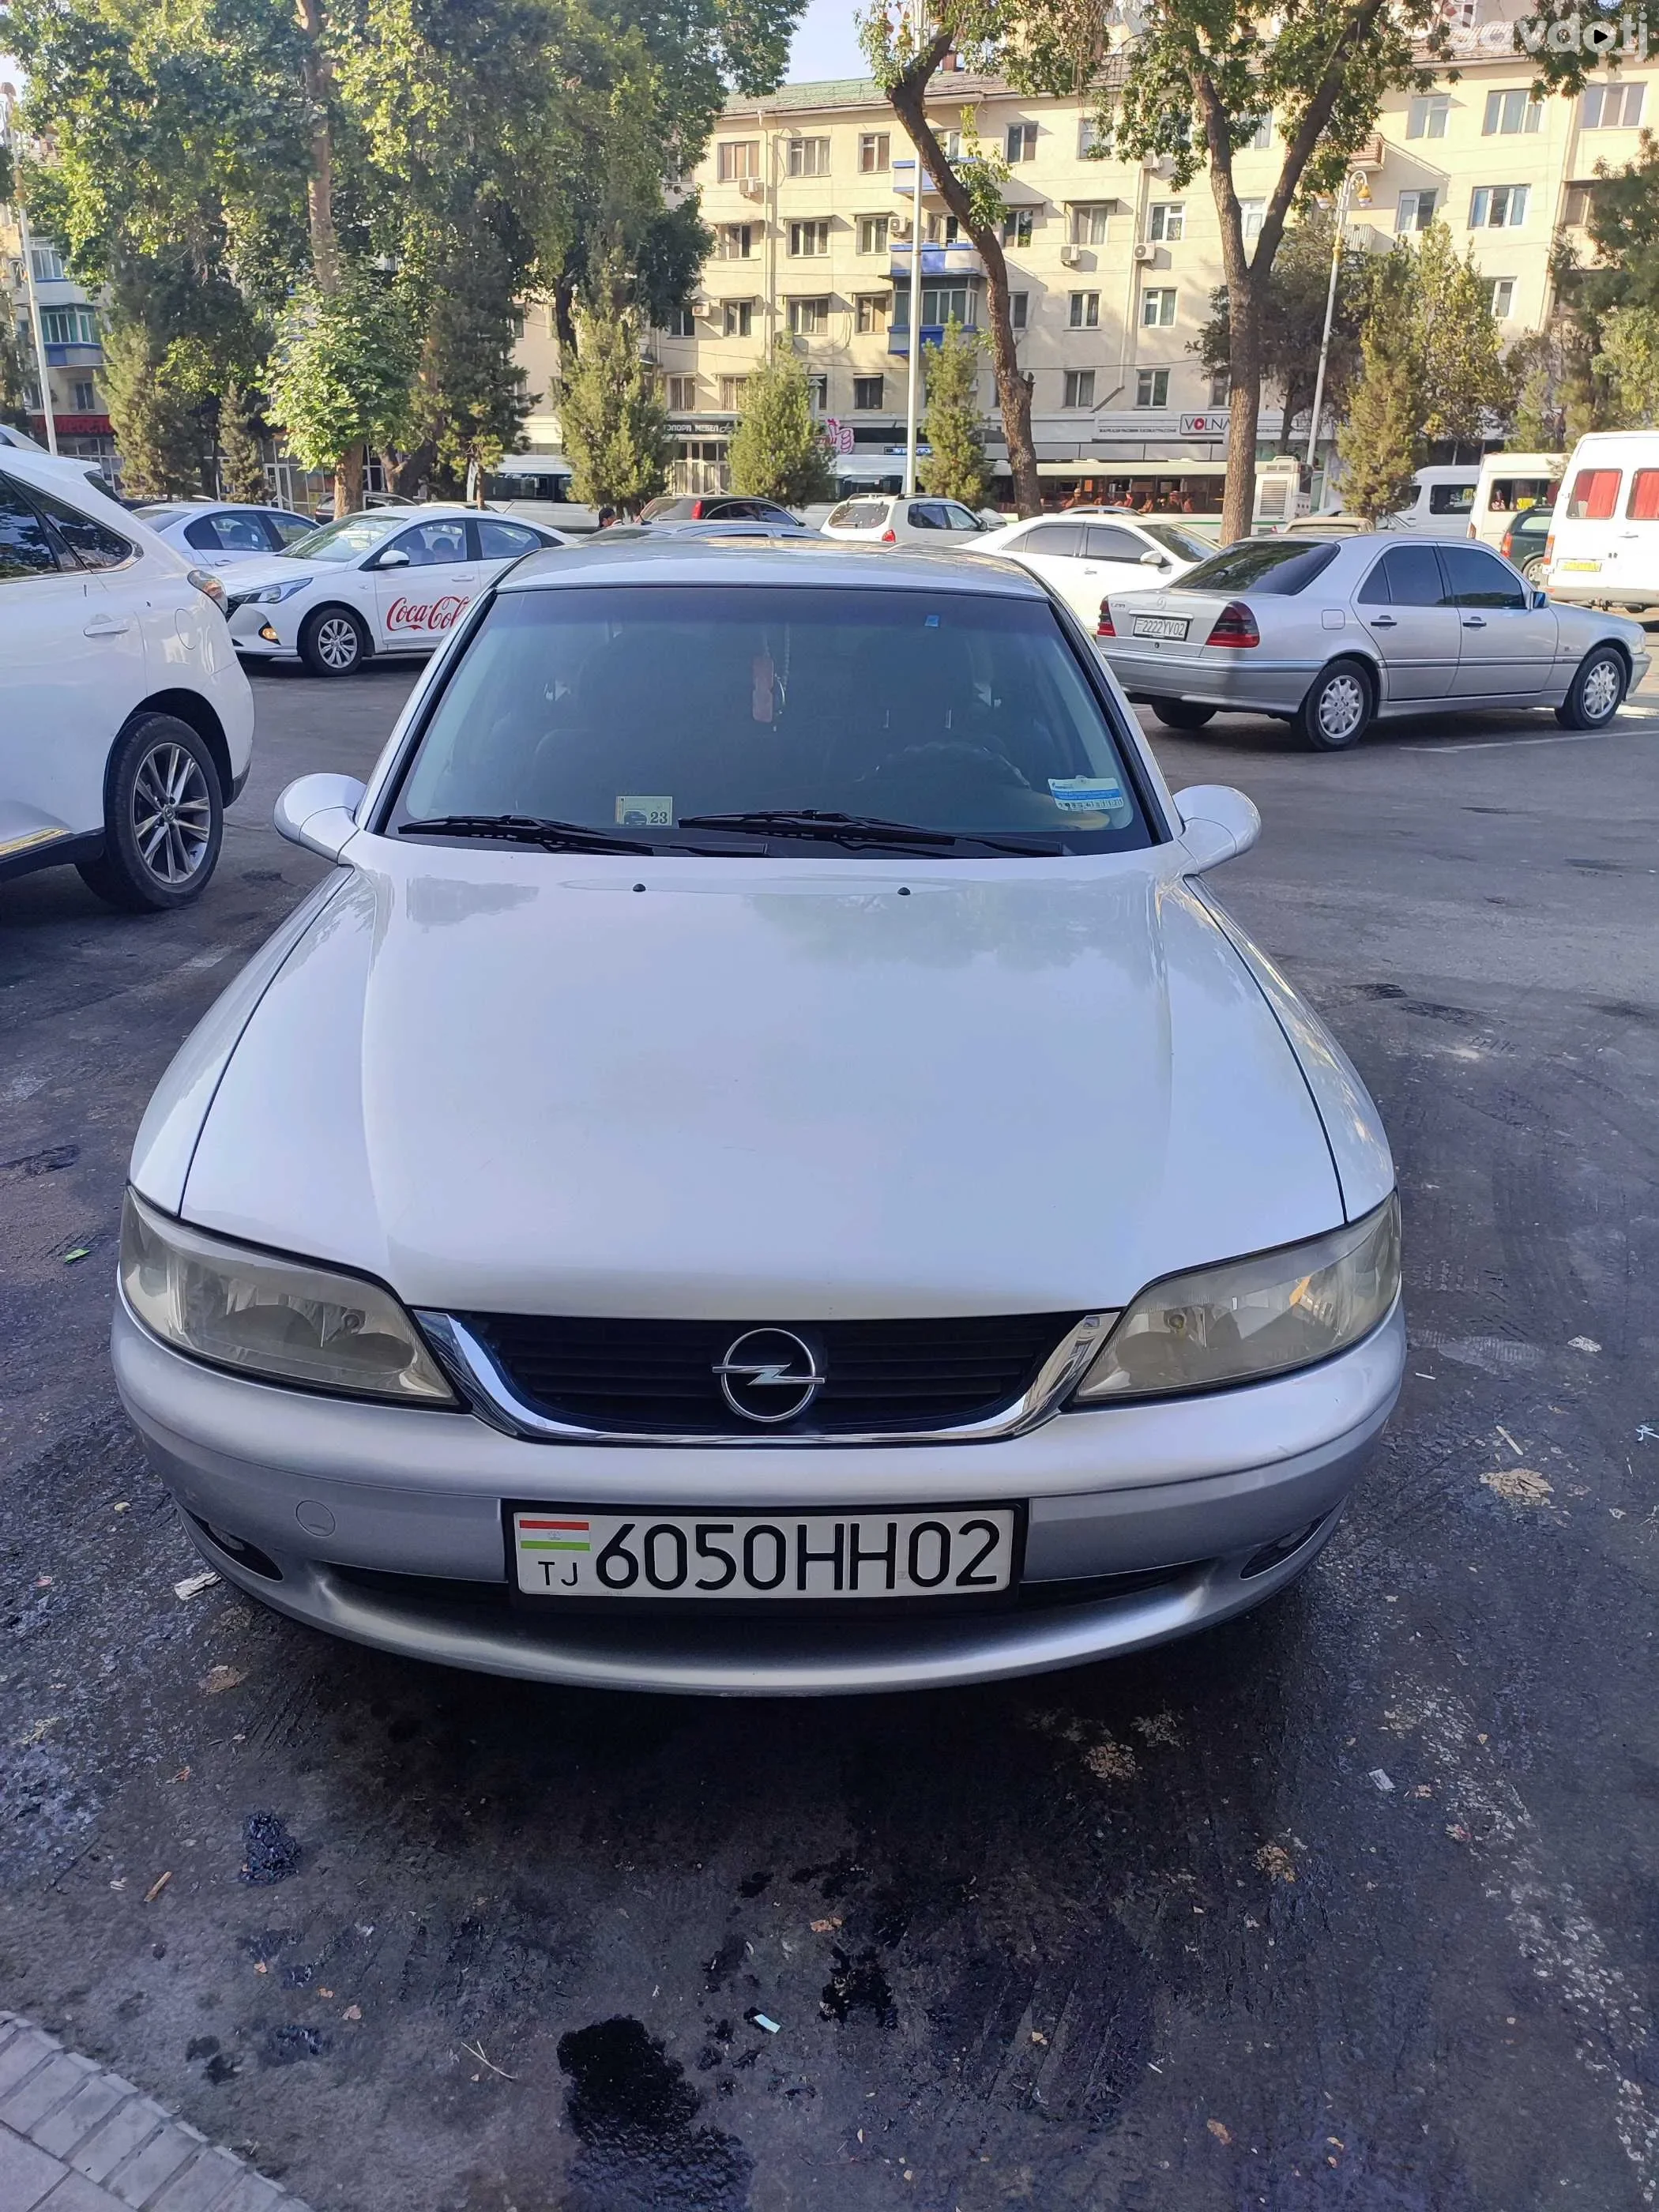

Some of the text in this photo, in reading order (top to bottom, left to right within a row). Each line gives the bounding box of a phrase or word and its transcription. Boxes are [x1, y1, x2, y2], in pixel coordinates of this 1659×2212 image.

[386, 596, 471, 631] Coca-Col
[650, 811, 668, 824] 23
[596, 1519, 1000, 1590] 6050HH02
[538, 1561, 577, 1586] TJ
